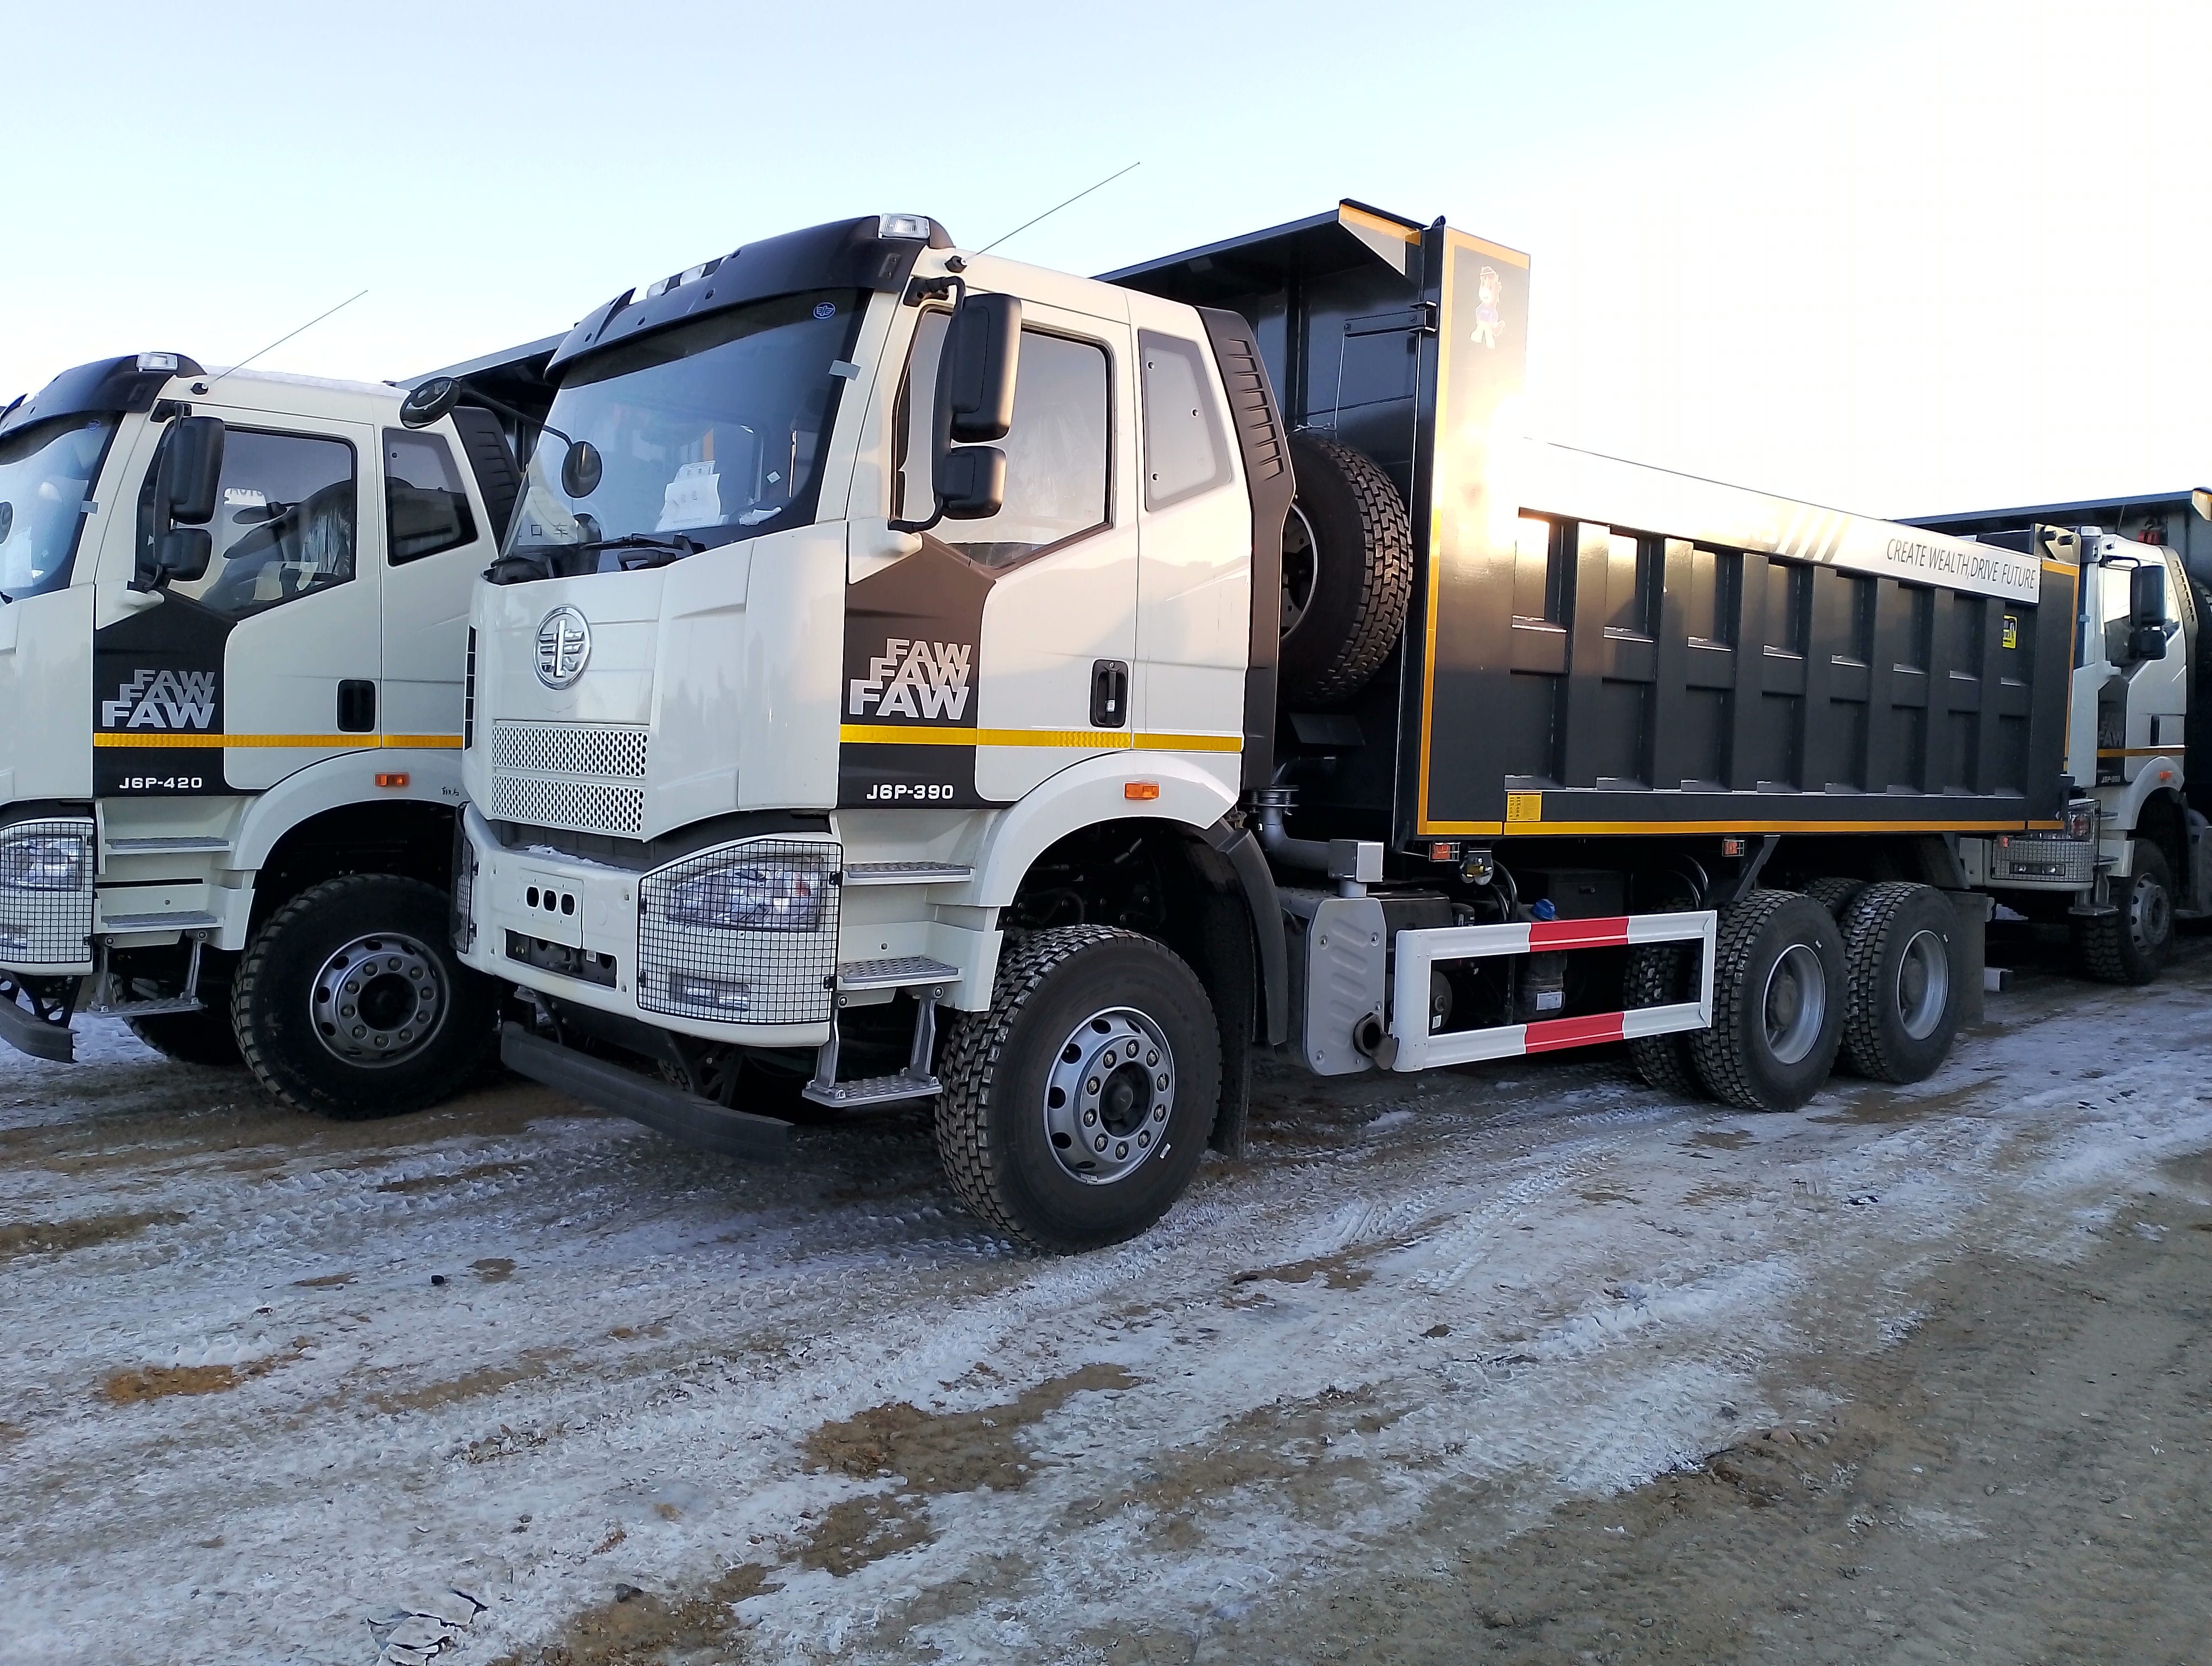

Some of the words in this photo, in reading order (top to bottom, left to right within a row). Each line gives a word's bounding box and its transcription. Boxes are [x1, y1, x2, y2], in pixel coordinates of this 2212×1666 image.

[519, 523, 568, 537] 口车
[1887, 539, 1927, 566] CREATE
[2001, 563, 2036, 589] FUTURE
[886, 638, 972, 669] FAW
[134, 669, 215, 690] FAW
[870, 657, 971, 692] FAW
[120, 684, 215, 707] FAW
[849, 679, 969, 720] FAW
[102, 701, 215, 728] FAW
[119, 777, 202, 789] J6P-420
[866, 785, 954, 799] J6P-390
